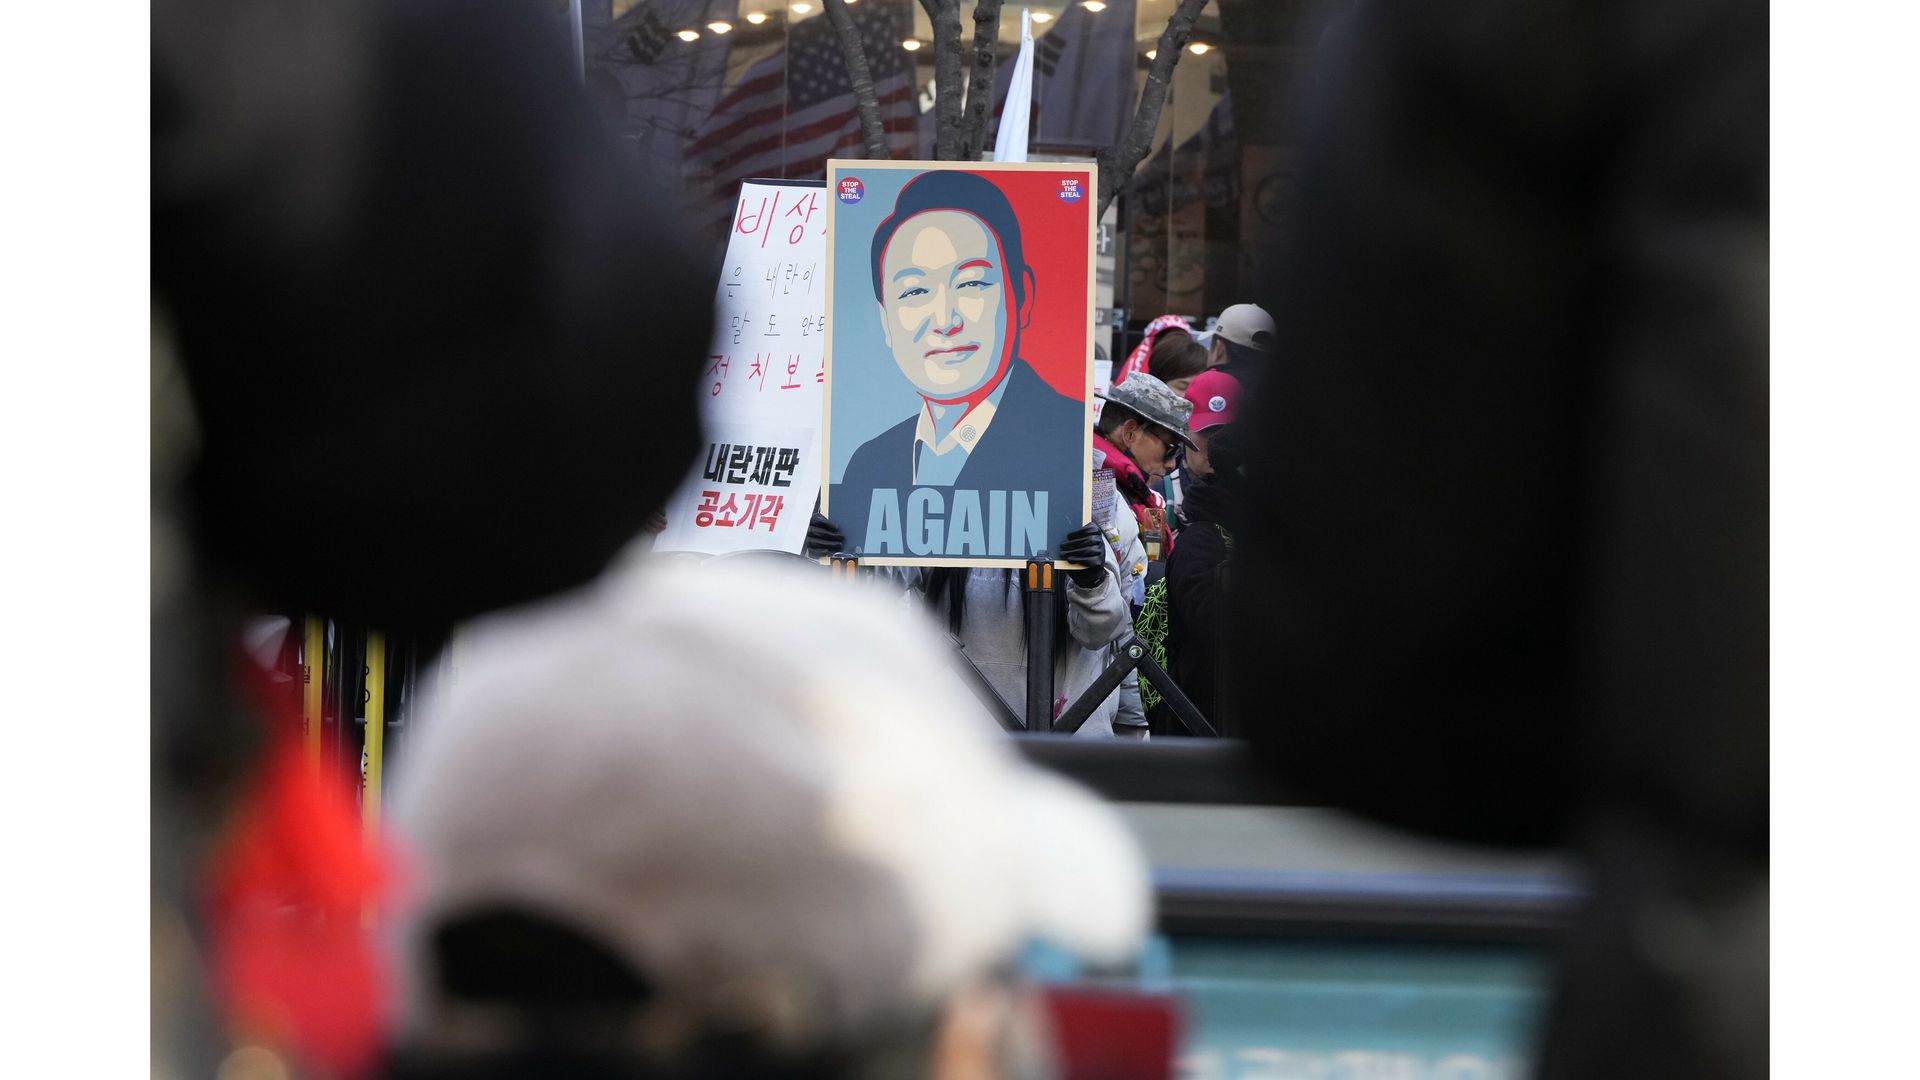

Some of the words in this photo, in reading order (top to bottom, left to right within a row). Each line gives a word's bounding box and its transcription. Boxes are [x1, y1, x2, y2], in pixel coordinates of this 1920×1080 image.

[735, 190, 826, 248] 비상
[703, 443, 800, 487] 내란재판
[695, 490, 784, 532] 공소기각
[863, 487, 1049, 556] AGAIN
